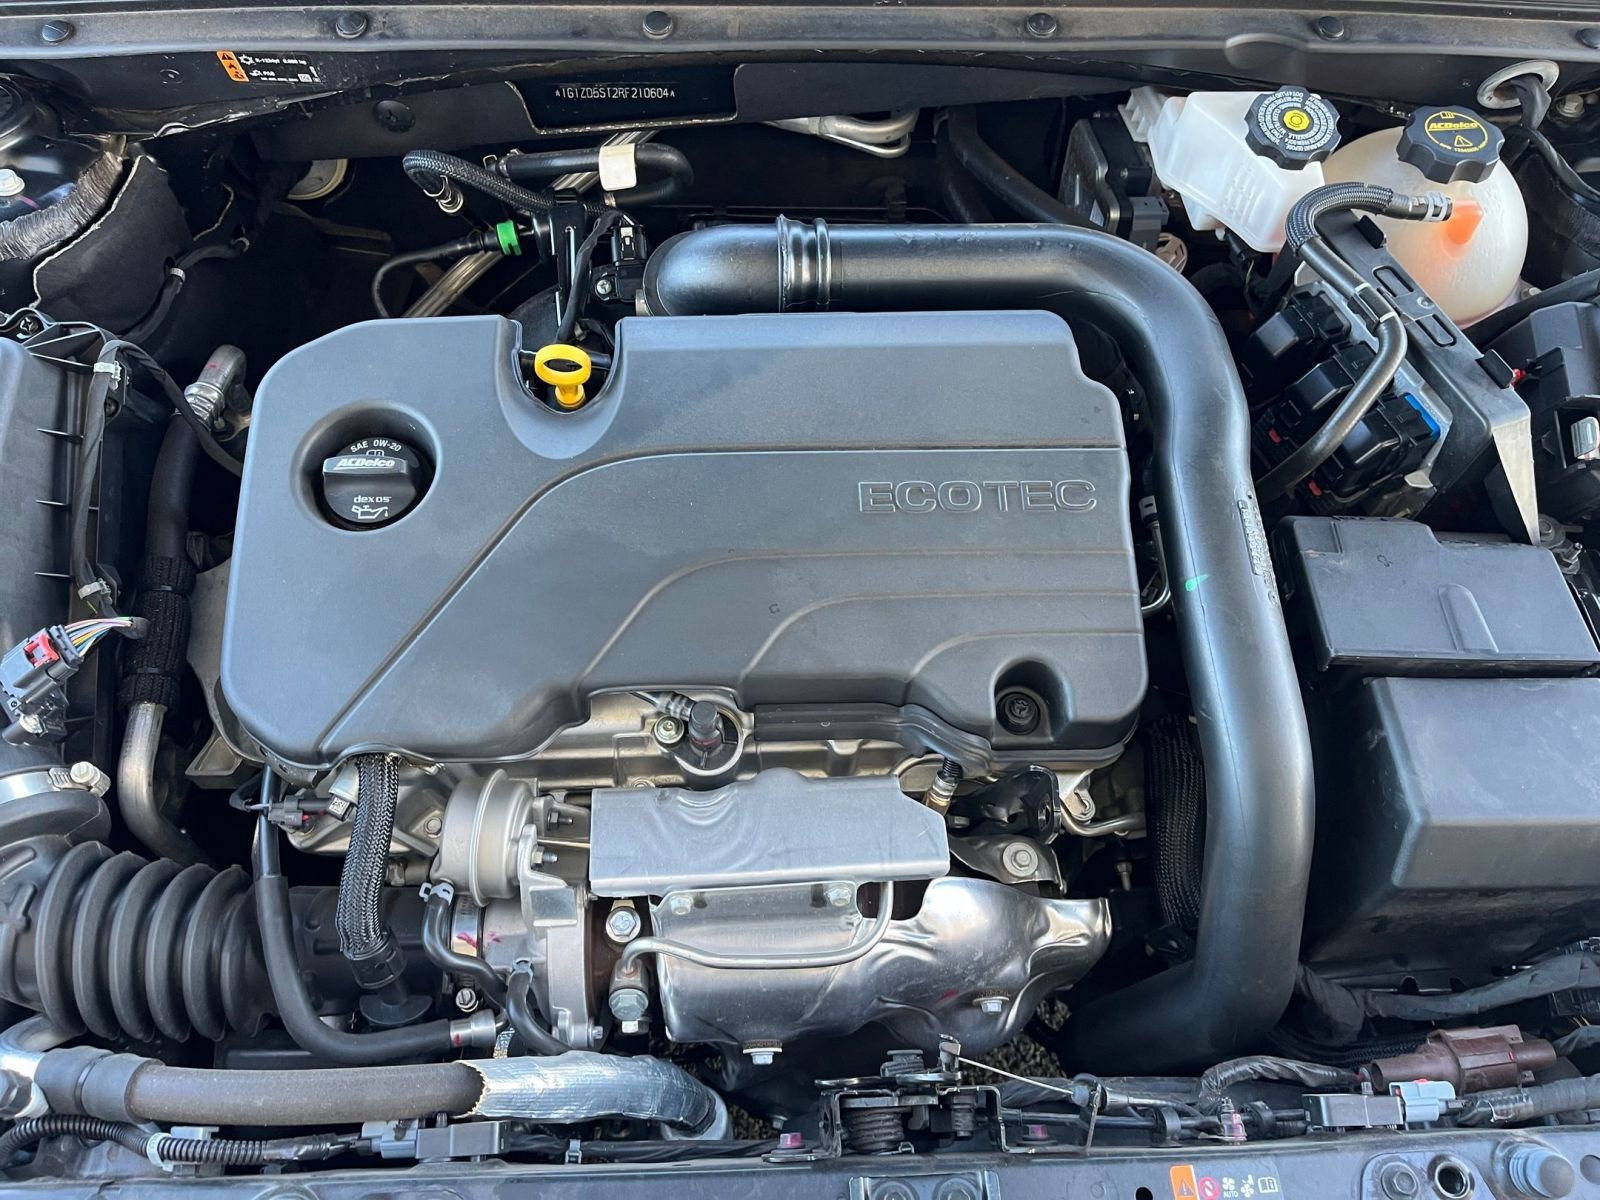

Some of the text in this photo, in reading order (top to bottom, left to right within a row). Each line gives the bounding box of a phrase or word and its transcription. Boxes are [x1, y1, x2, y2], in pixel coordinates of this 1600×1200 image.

[1429, 122, 1478, 130] ACDelco
[350, 440, 402, 452] SAE 0W-20
[336, 458, 395, 467] ACDelco
[858, 480, 1096, 513] ECOTEC
